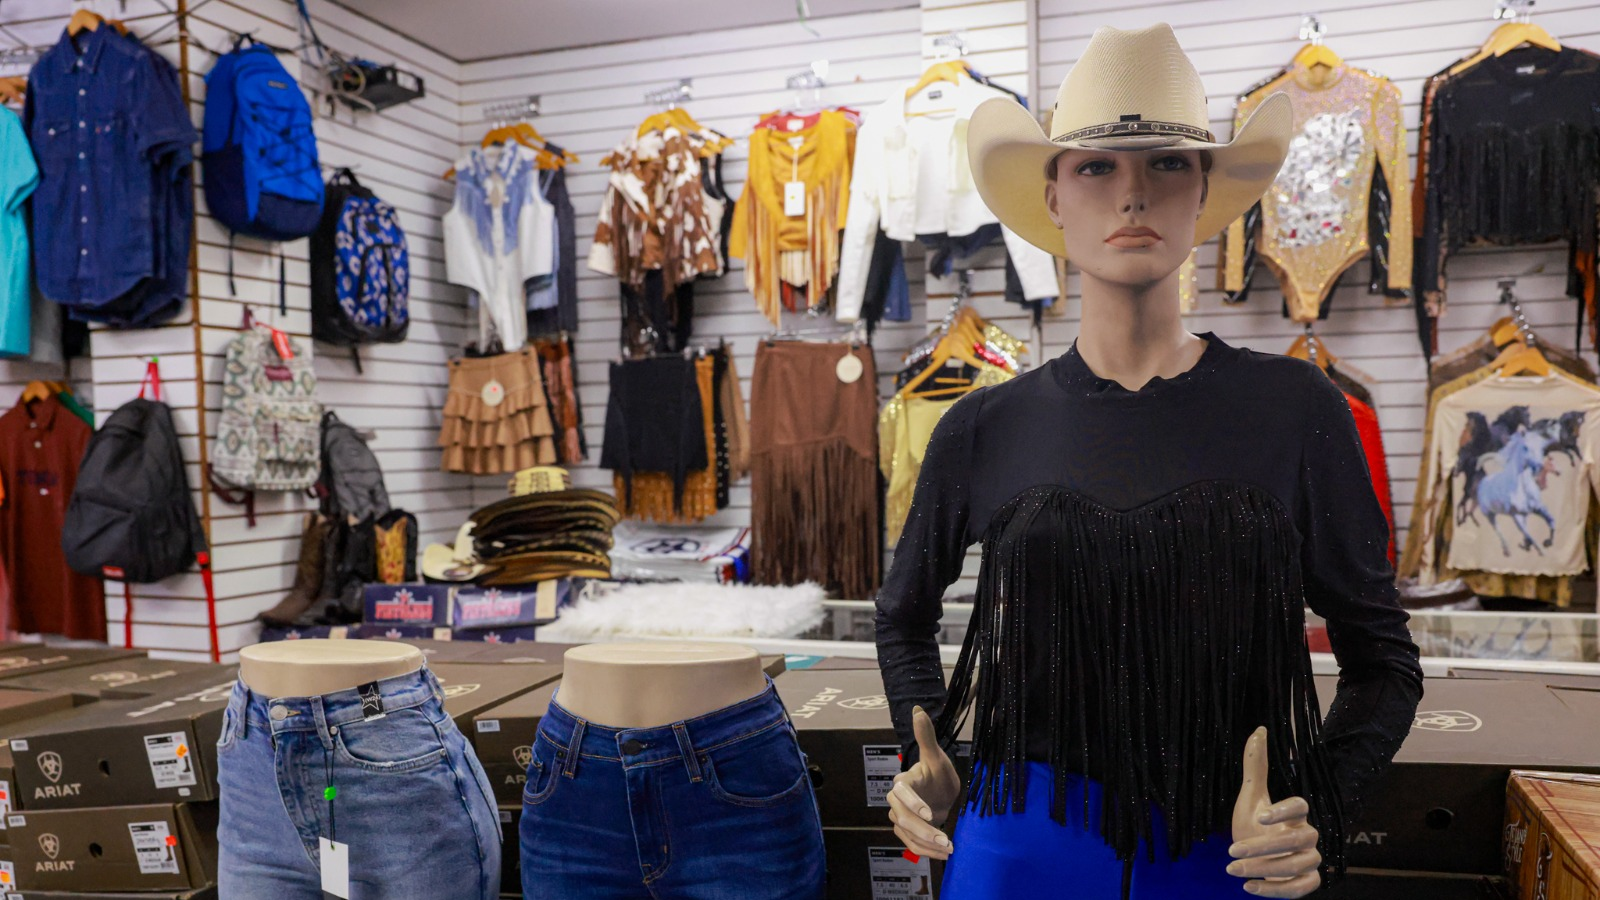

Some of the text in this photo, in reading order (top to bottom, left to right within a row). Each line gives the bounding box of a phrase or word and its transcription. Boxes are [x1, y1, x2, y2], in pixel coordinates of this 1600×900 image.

[790, 687, 842, 718] ARIAT
[34, 783, 81, 799] ARIAT
[1345, 831, 1387, 844] IAT
[35, 860, 75, 872] ARIAT
